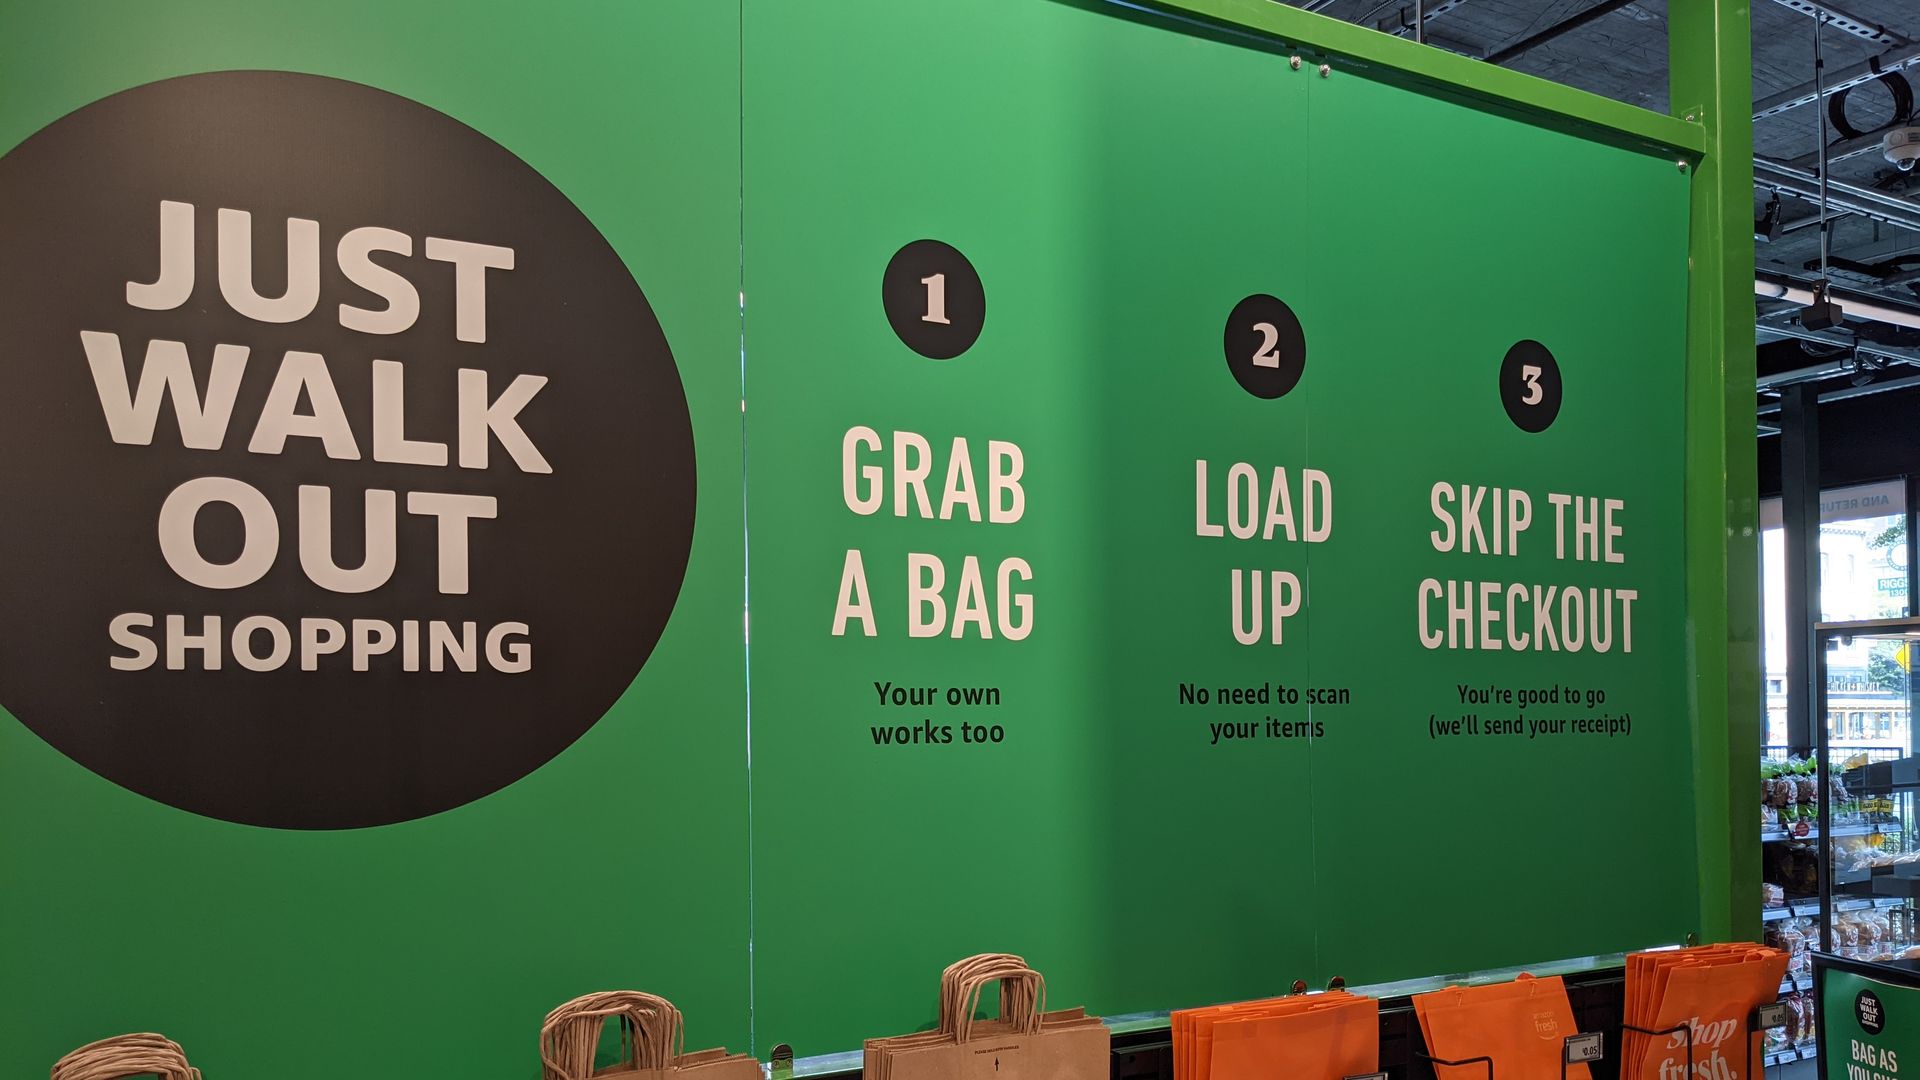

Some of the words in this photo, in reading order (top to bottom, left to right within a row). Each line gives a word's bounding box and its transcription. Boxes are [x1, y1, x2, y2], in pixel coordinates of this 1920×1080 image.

[126, 199, 515, 344] JUST
[921, 273, 951, 325] 1
[1252, 322, 1280, 369] 2
[80, 330, 553, 475] WALK
[1522, 364, 1543, 405] 3
[842, 425, 1026, 524] GRAB
[1196, 459, 1332, 543] LOAD
[158, 476, 498, 595] OUT
[1430, 481, 1532, 556] SKIP
[1548, 493, 1624, 564] THE
[831, 549, 878, 637] A
[907, 552, 1034, 641] BAG
[1231, 569, 1302, 646] UP
[1418, 578, 1638, 653] CHECKOUT
[109, 612, 533, 674] SHOPPING
[874, 681, 938, 705] Your
[946, 687, 1000, 706] own
[1179, 683, 1210, 705] No
[1217, 682, 1270, 705] need
[1277, 684, 1299, 705] to
[1305, 688, 1350, 705] scan
[1457, 684, 1513, 705] You're
[1518, 684, 1559, 709] good
[1564, 686, 1581, 704] to
[1586, 689, 1606, 709] go
[871, 718, 953, 745] works
[961, 721, 1005, 744] too
[1210, 722, 1260, 745] your
[1265, 716, 1325, 739] items
[1429, 714, 1479, 740] (we'll
[1484, 714, 1524, 736] send
[1529, 719, 1567, 740] your
[1571, 713, 1632, 738] receipt)
[1860, 1003, 1879, 1015] WALK
[1861, 996, 1876, 1007] JUST
[1863, 1012, 1876, 1022] OUT
[1535, 1018, 1558, 1033] fresh
[1667, 1016, 1738, 1049] Shop
[1851, 1039, 1876, 1067] BAG
[1880, 1048, 1898, 1073] AS
